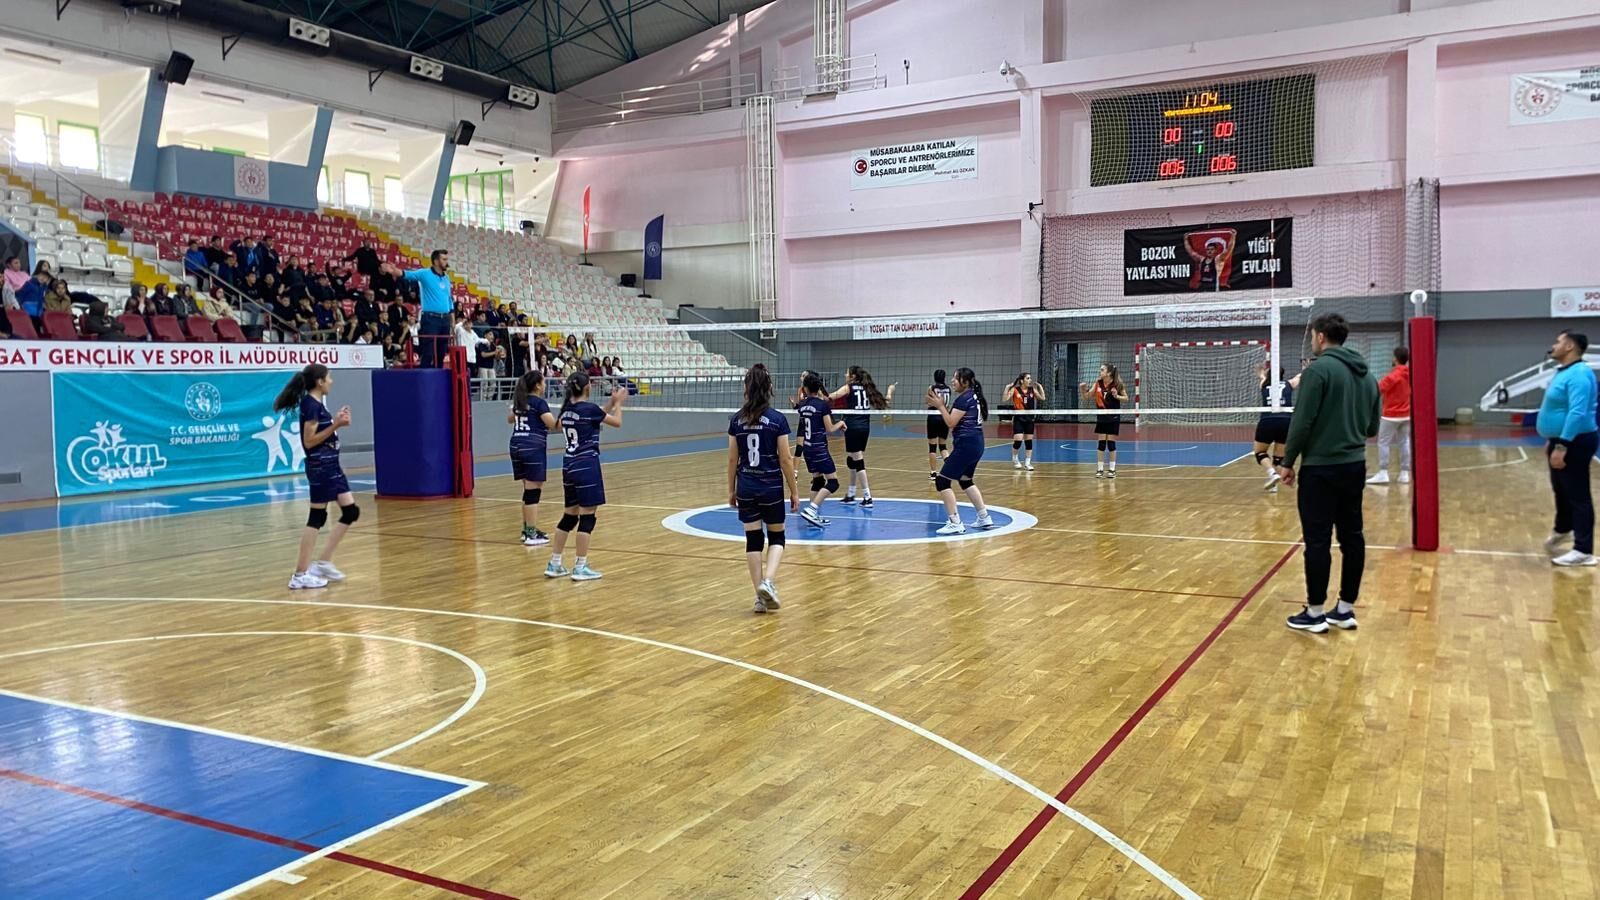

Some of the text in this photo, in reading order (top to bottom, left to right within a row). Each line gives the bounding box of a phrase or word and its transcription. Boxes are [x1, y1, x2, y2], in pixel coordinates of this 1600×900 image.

[1164, 127, 1181, 144] 00
[1215, 122, 1233, 138] 00
[870, 140, 956, 157] MÜSABAKALARA KATILAN
[870, 147, 975, 167] SPORCU VE ANTRENÖRLERİMİZE
[870, 163, 937, 178] BAŞARILAR DİLERİM.
[1160, 160, 1185, 176] 006
[1211, 155, 1237, 172] 006
[1141, 245, 1177, 261] BOZOK
[1247, 236, 1275, 254] YİĞİT
[1126, 264, 1190, 281] YAYLASI'NIN
[1242, 258, 1281, 275] EVLADI
[0, 345, 339, 368] GAT GENÇLİK VE SPOR İL MÜDÜRLÜĞÜ
[169, 423, 240, 435] T.C. GENÇLİK VE
[514, 415, 531, 431] 15
[169, 432, 240, 446] SPOR BAKANLIĞI
[562, 427, 580, 453] 13
[746, 433, 760, 467] 8
